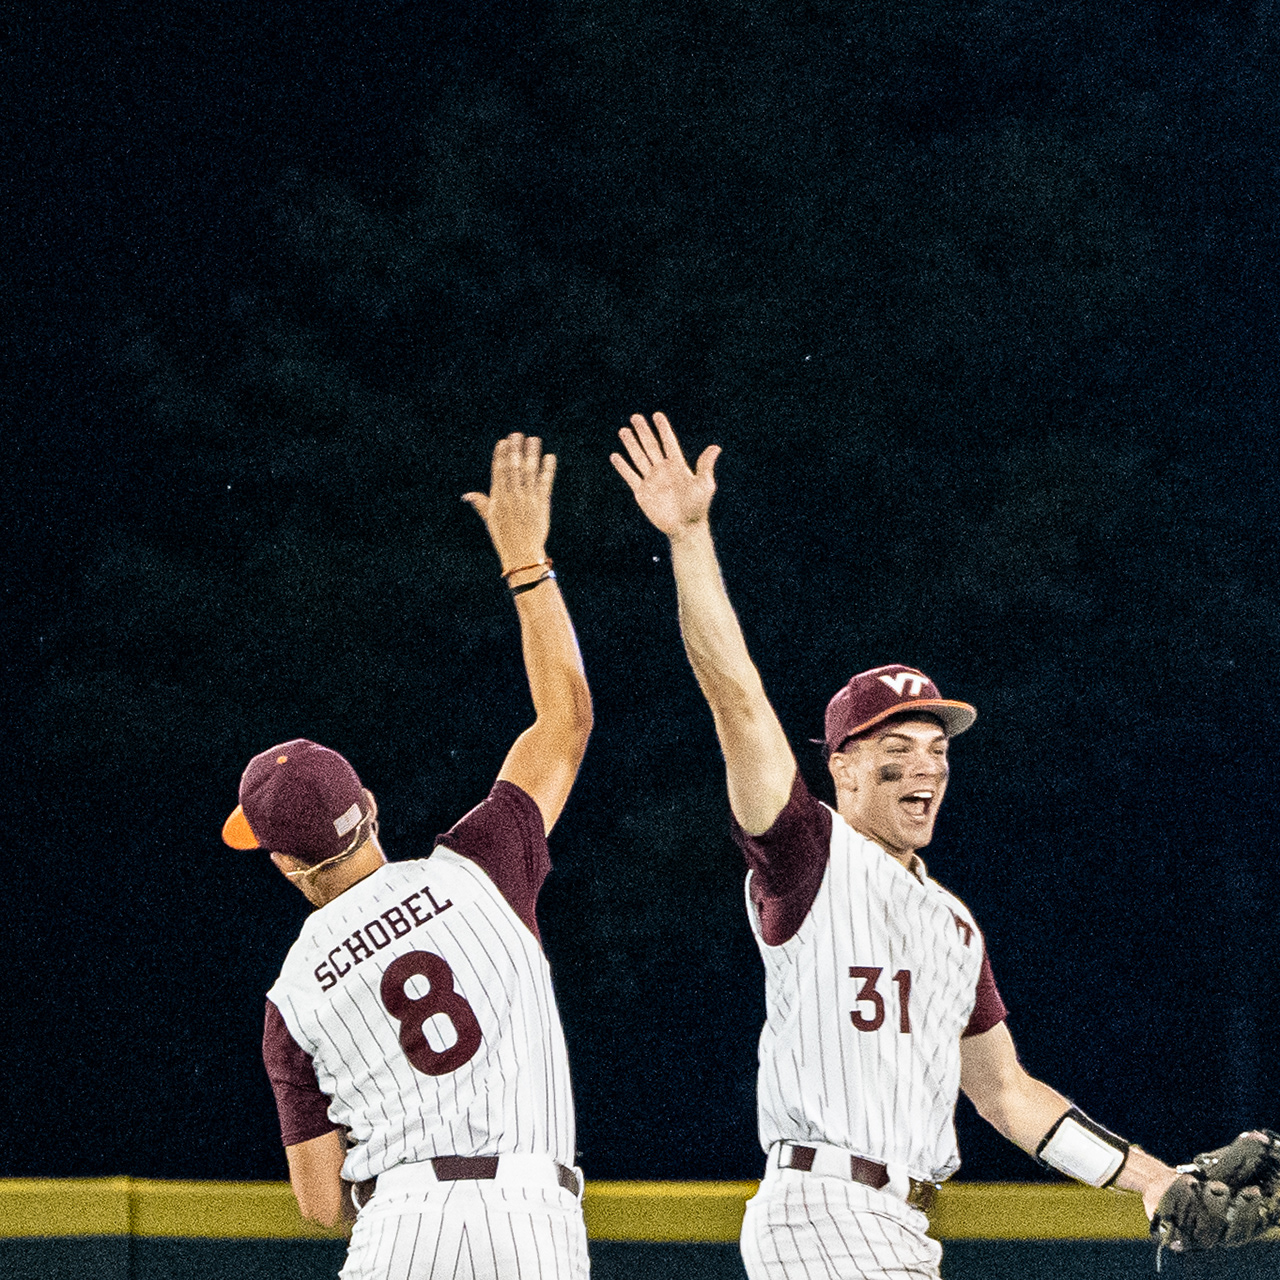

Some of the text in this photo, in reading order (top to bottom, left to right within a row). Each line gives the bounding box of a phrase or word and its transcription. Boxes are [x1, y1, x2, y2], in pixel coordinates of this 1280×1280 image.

[314, 886, 454, 993] SCHOBEL
[380, 950, 483, 1077] 8
[848, 966, 913, 1034] 31
